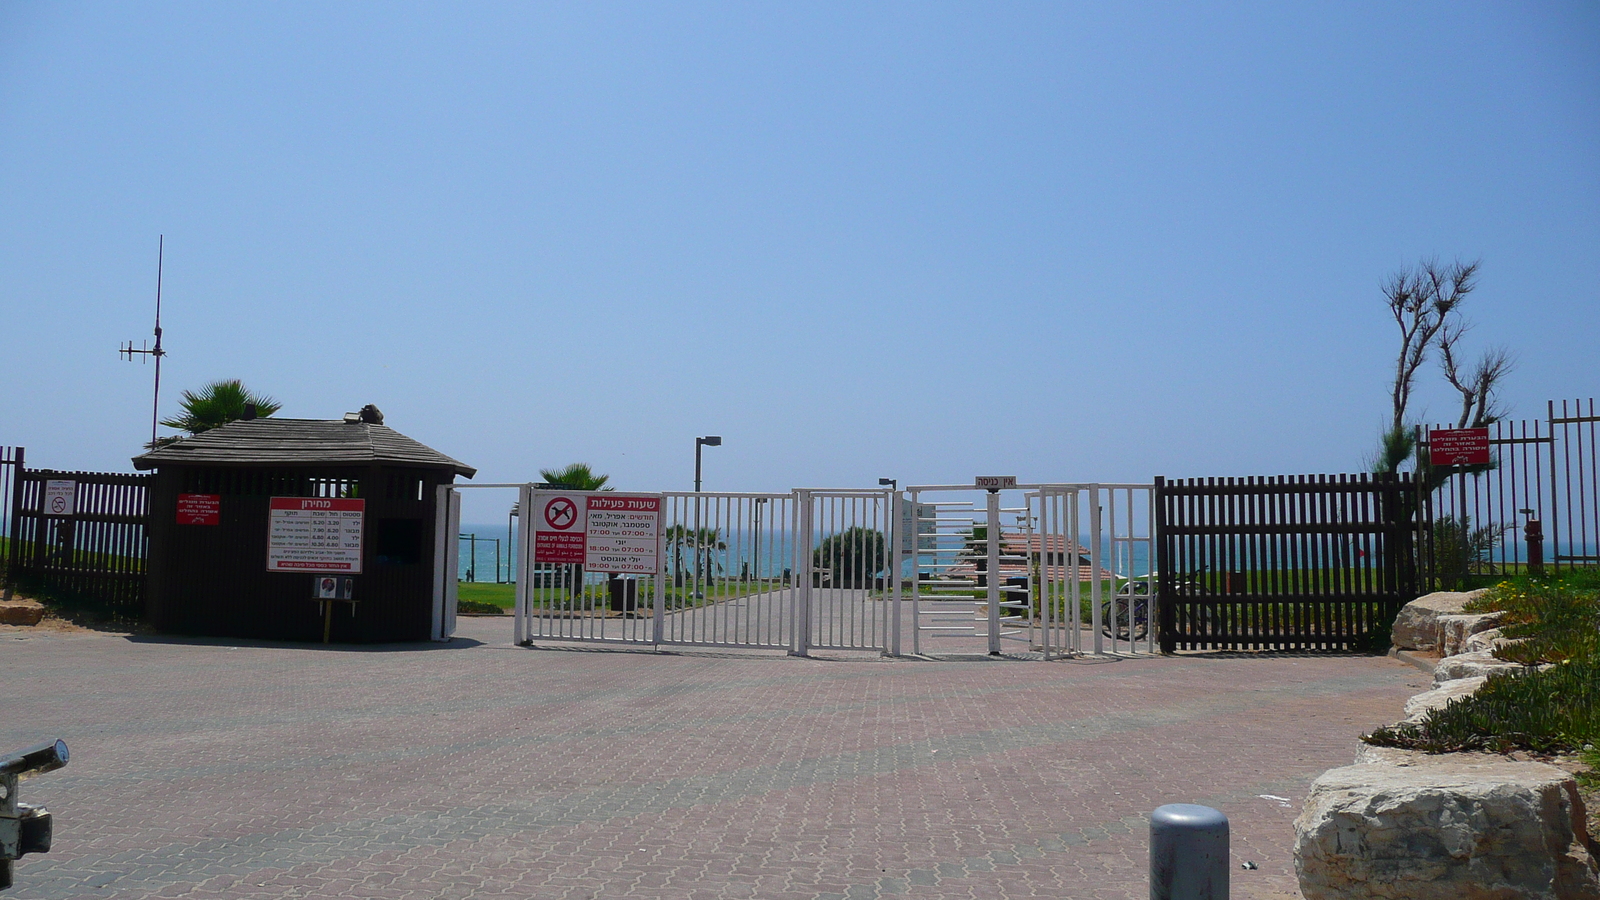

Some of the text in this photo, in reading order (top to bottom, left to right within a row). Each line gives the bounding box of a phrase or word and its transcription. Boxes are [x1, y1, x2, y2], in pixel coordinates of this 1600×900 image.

[978, 478, 1014, 488] אין כניסה
[301, 500, 331, 509] מחירון
[591, 498, 656, 509] שעות פעילות
